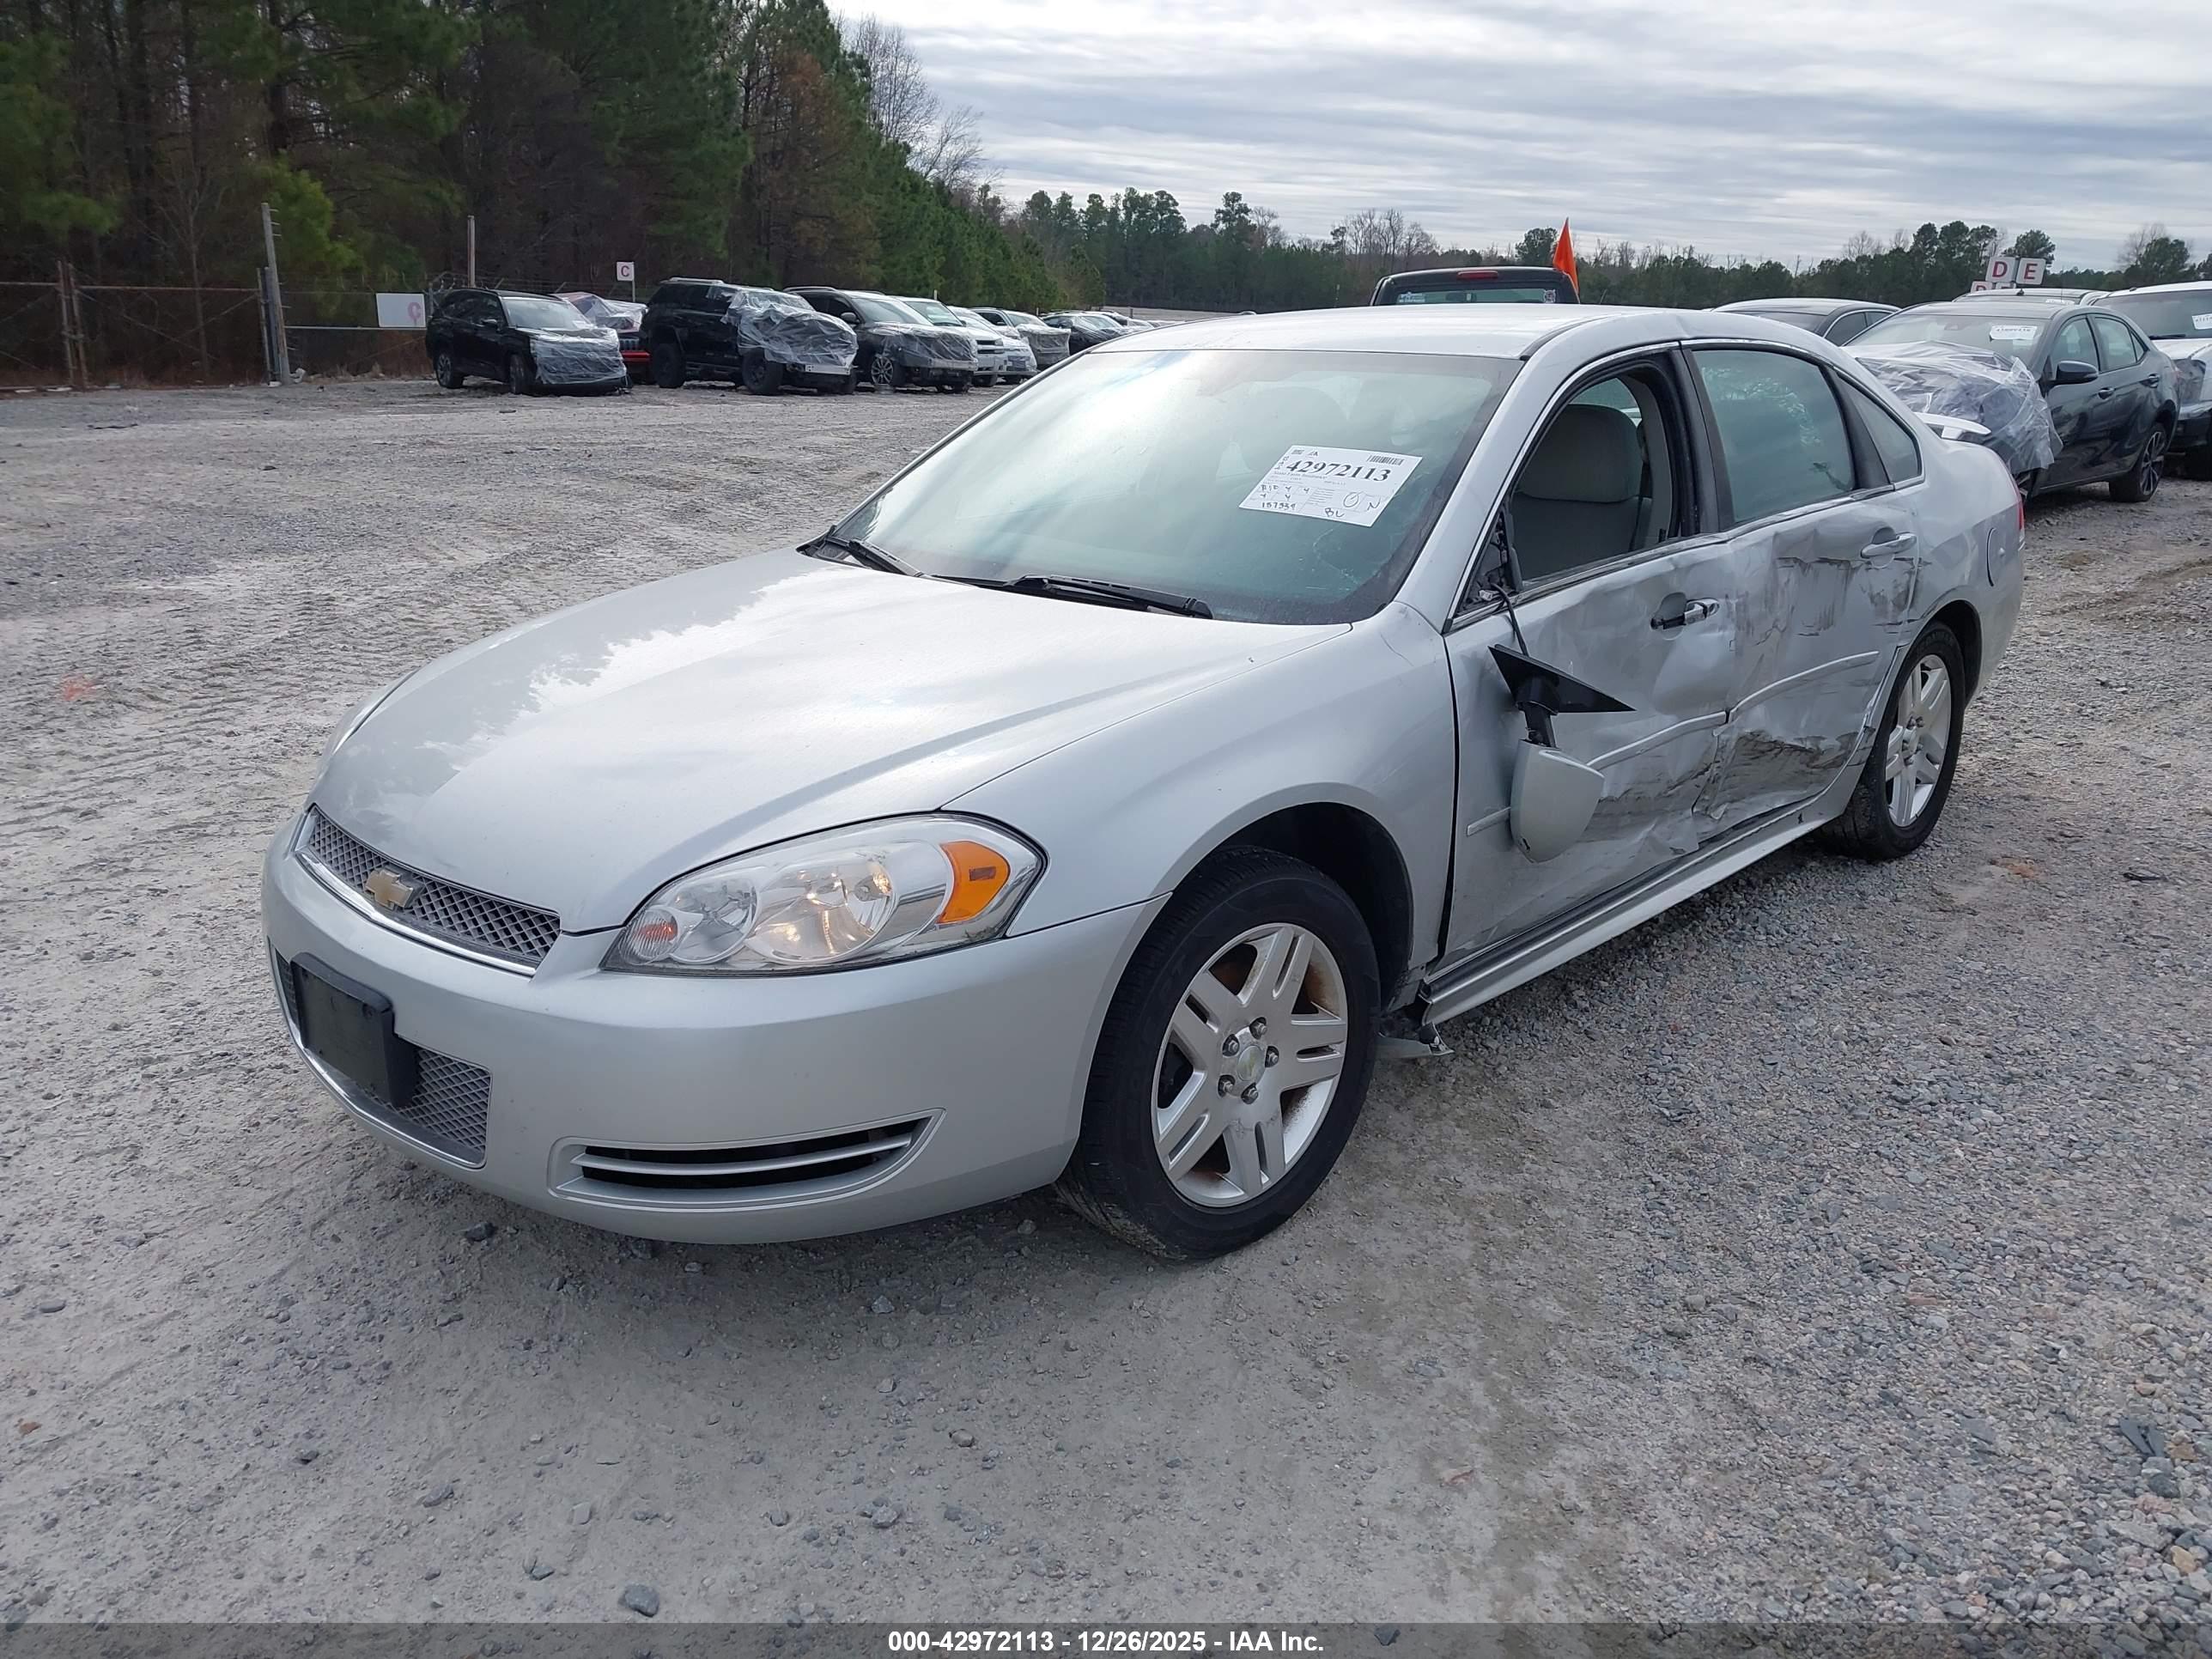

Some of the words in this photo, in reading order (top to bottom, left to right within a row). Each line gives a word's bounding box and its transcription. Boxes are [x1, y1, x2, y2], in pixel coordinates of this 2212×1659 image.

[621, 265, 629, 277] C
[1992, 261, 2008, 277] D
[2024, 264, 2038, 279] E
[1286, 460, 1391, 482] 42972113
